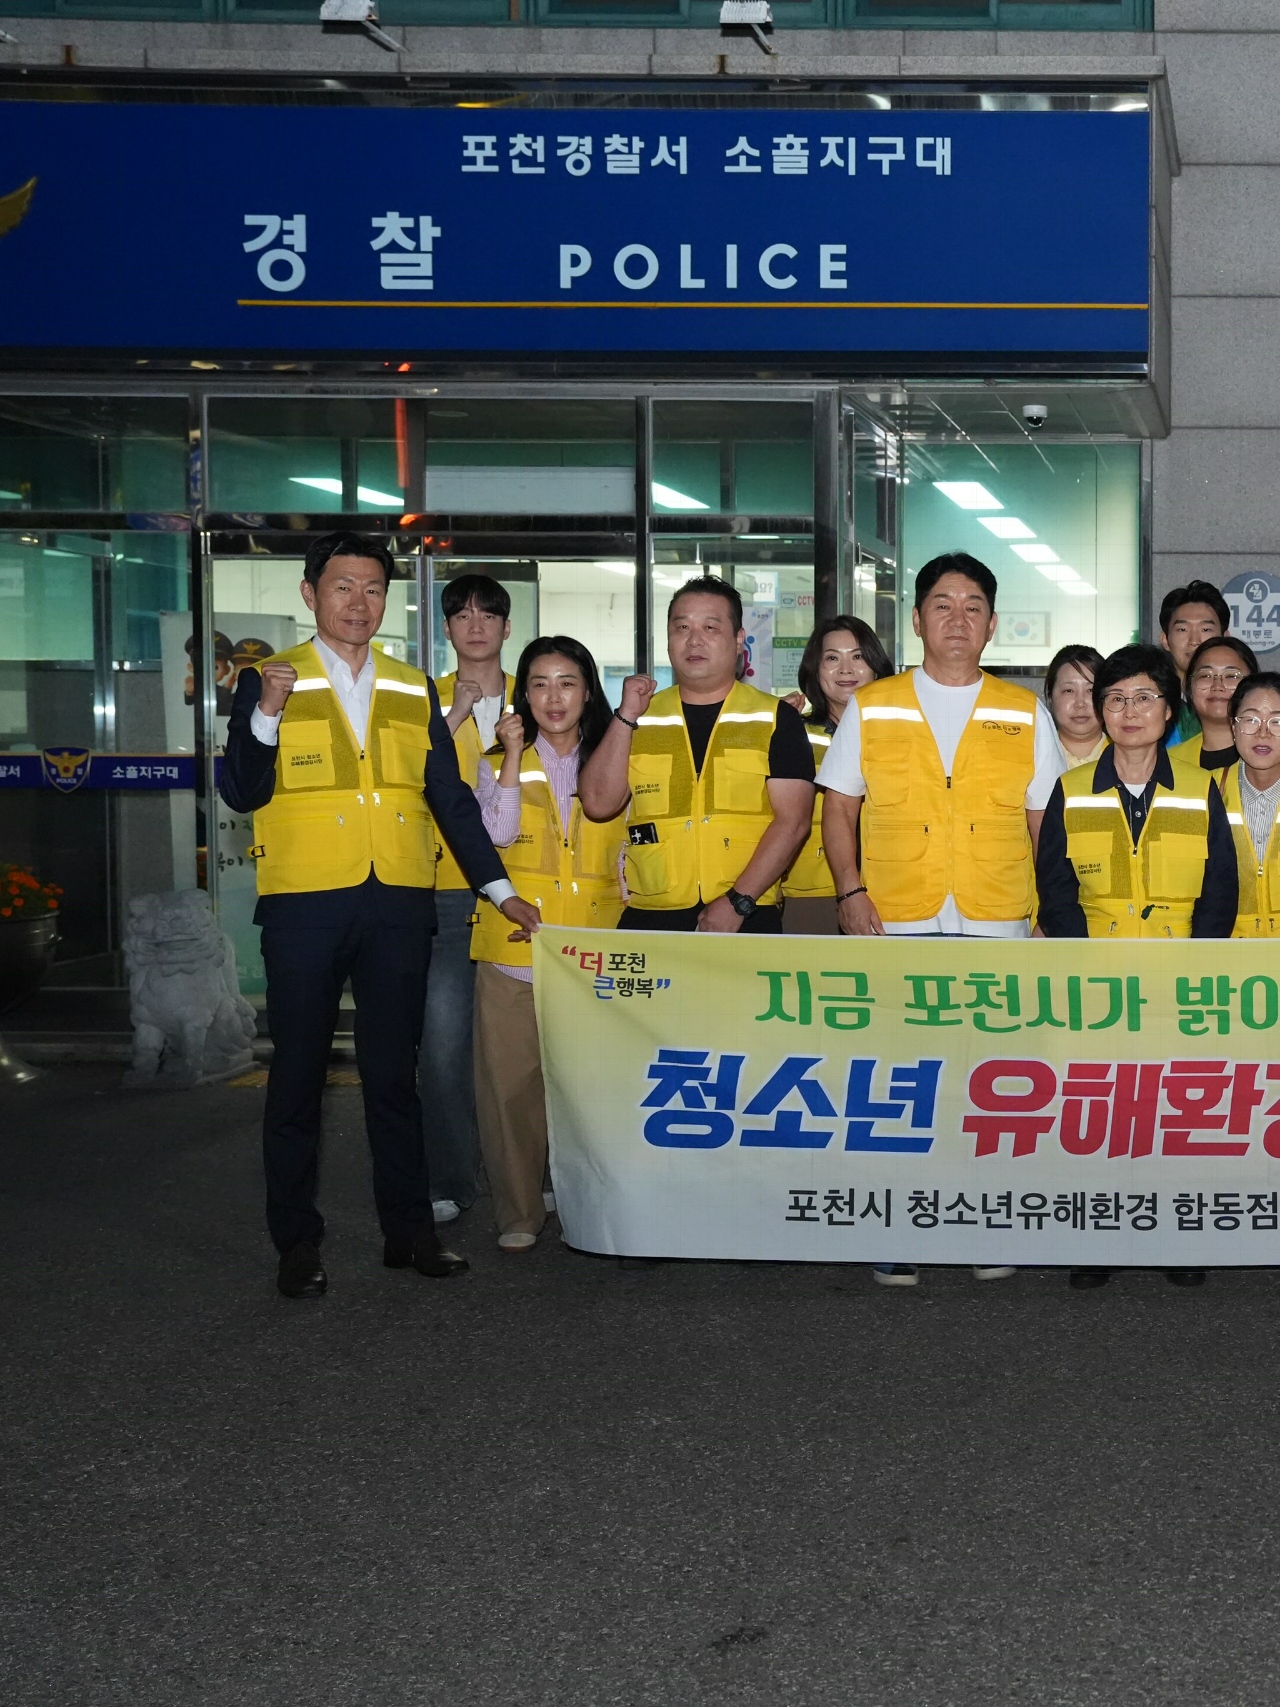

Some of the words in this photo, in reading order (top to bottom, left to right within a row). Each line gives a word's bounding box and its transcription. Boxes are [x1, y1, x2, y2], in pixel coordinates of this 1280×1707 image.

[461, 133, 688, 176] 포천경찰서
[724, 133, 952, 176] 소흘지구대
[559, 243, 848, 290] POLICE
[775, 638, 798, 647] CCTV
[112, 766, 179, 779] 소흘지구대
[607, 952, 646, 974] 포천
[755, 971, 876, 1031] 지금
[903, 972, 1148, 1033] 포천시가
[639, 1048, 943, 1154] 청소년
[785, 1187, 892, 1228] 포천시
[906, 1189, 1159, 1231] 청소년유해환경
